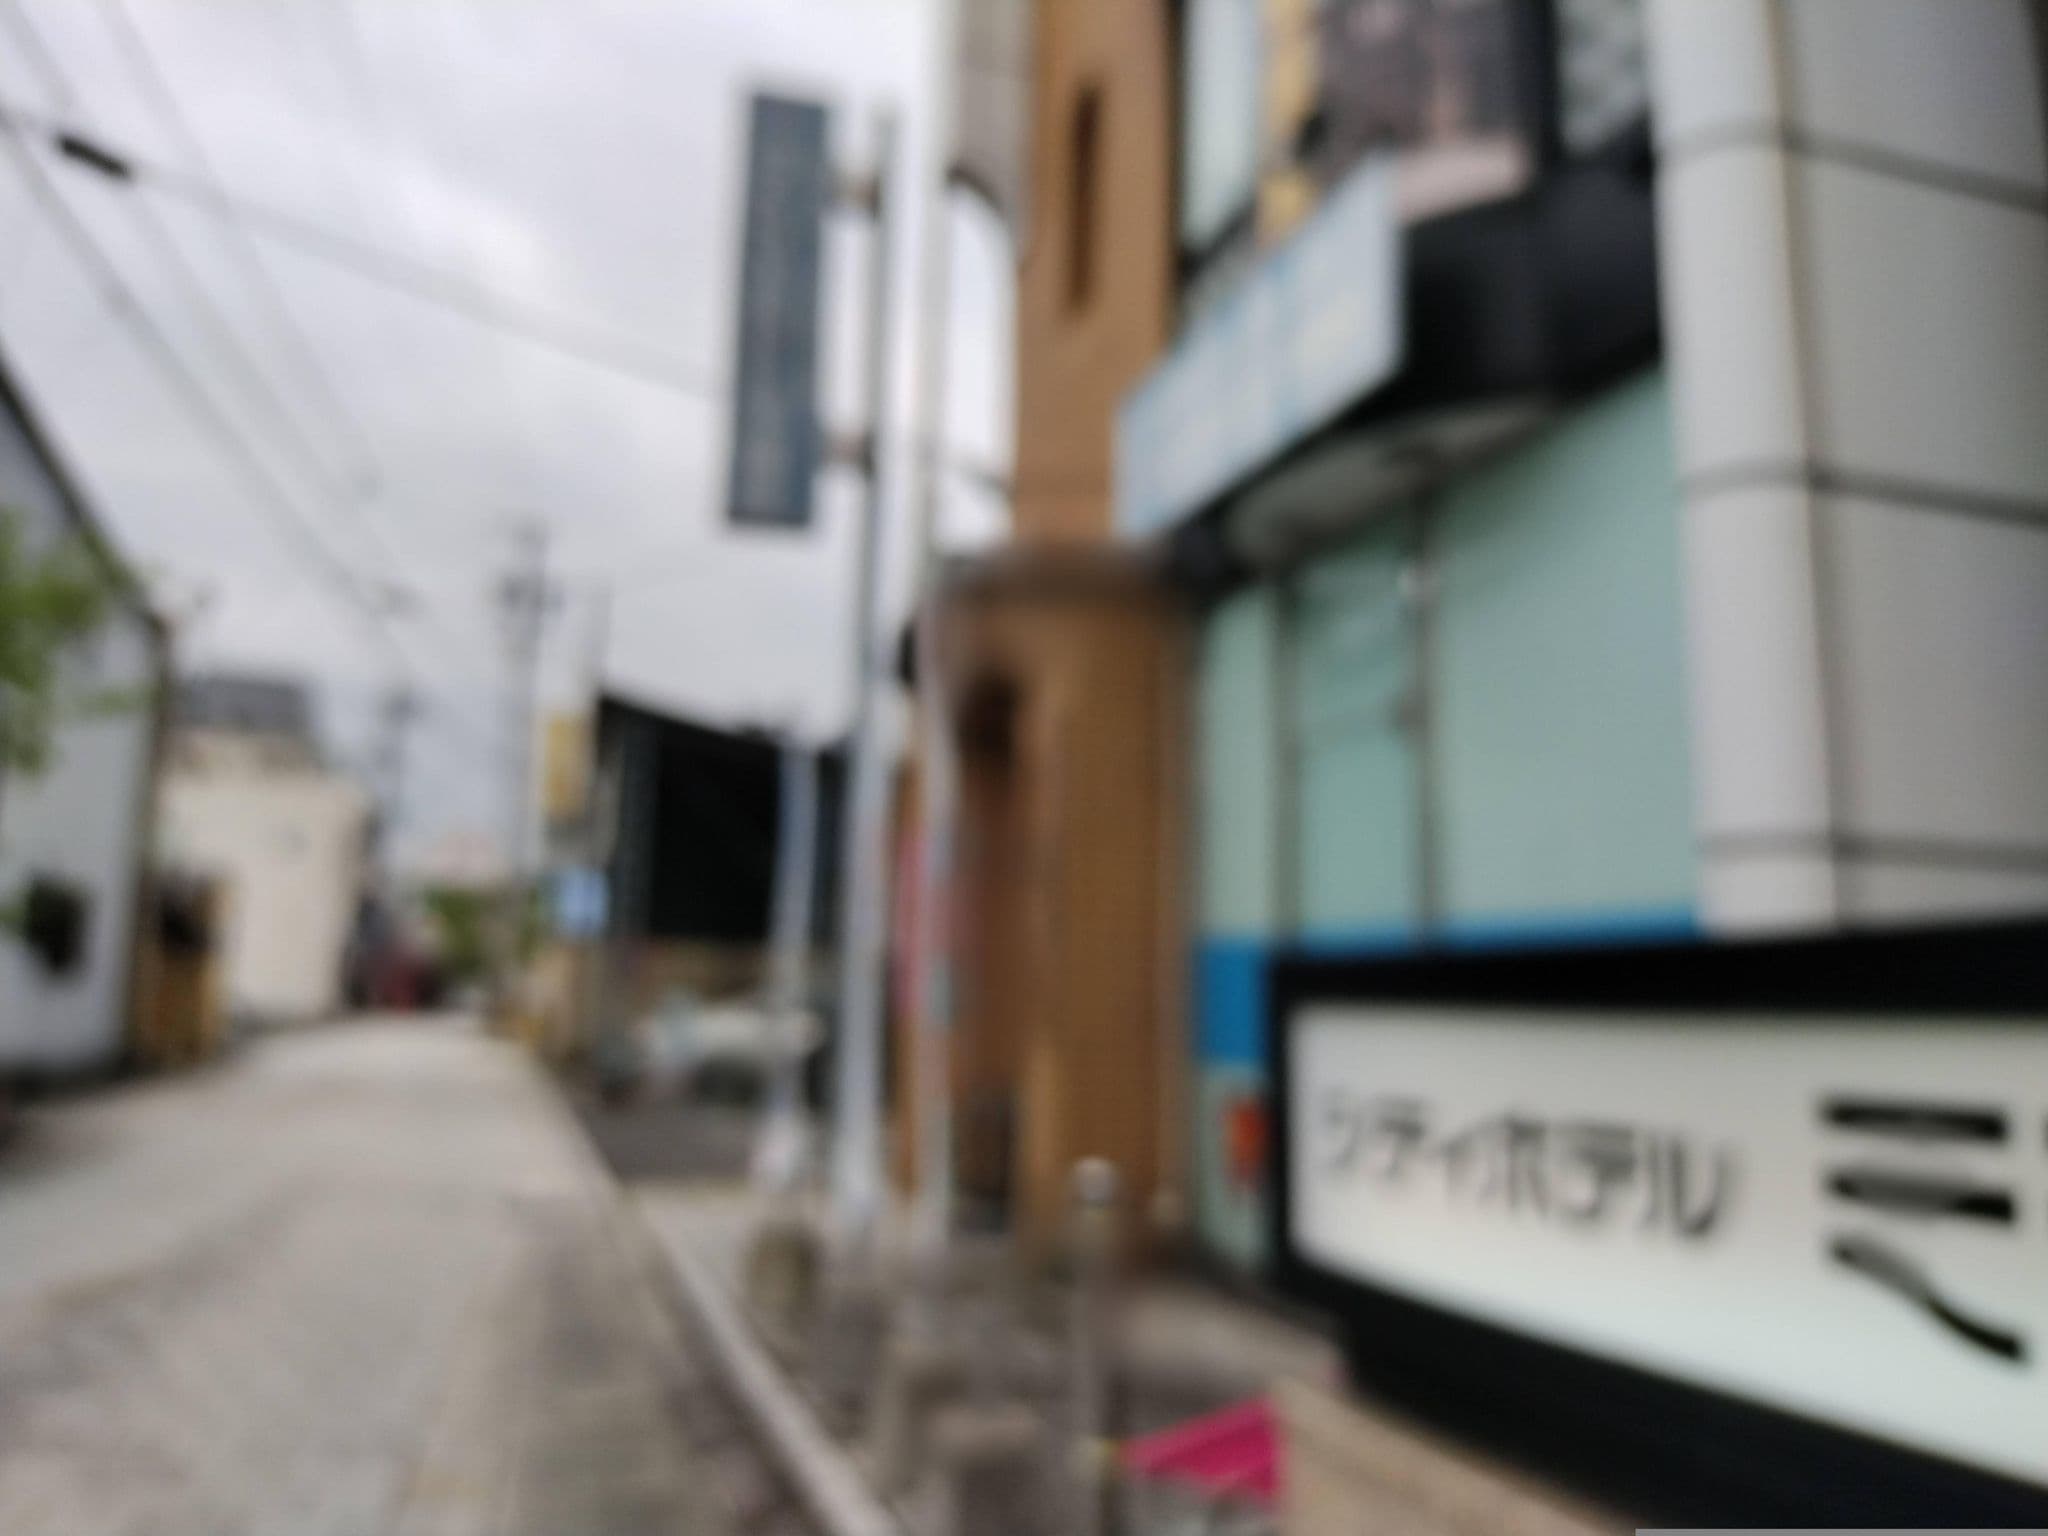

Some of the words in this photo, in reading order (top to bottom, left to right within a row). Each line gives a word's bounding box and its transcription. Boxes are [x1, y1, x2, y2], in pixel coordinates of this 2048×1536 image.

[1318, 1090, 1738, 1243] シティホテル
[1818, 1093, 2047, 1364] ミ
